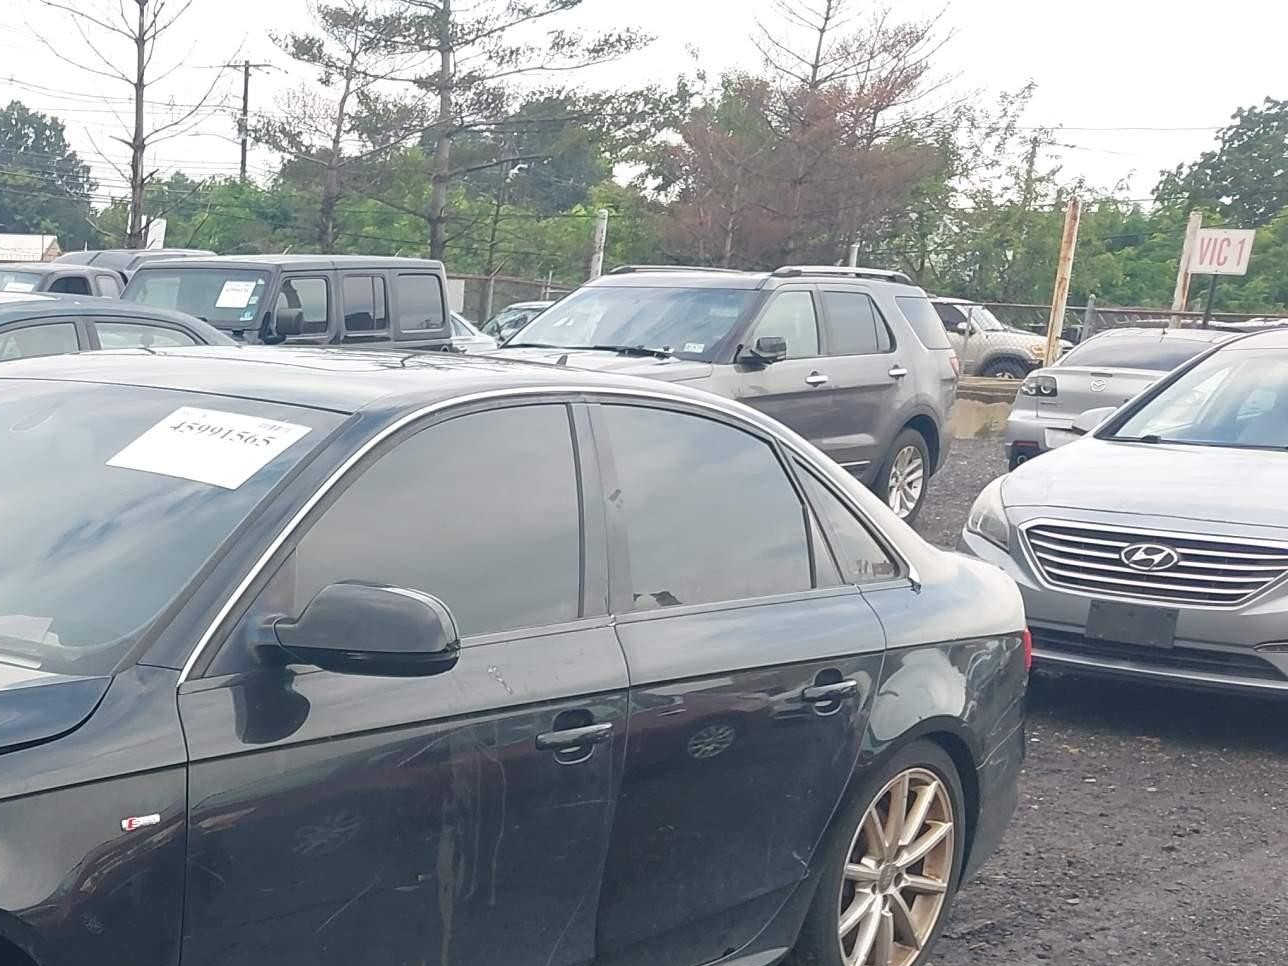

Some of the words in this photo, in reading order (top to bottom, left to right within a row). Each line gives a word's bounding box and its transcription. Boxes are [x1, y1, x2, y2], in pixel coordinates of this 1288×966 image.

[1199, 237, 1231, 267] VIC
[1237, 238, 1246, 267] 1
[169, 421, 276, 447] 45991565
